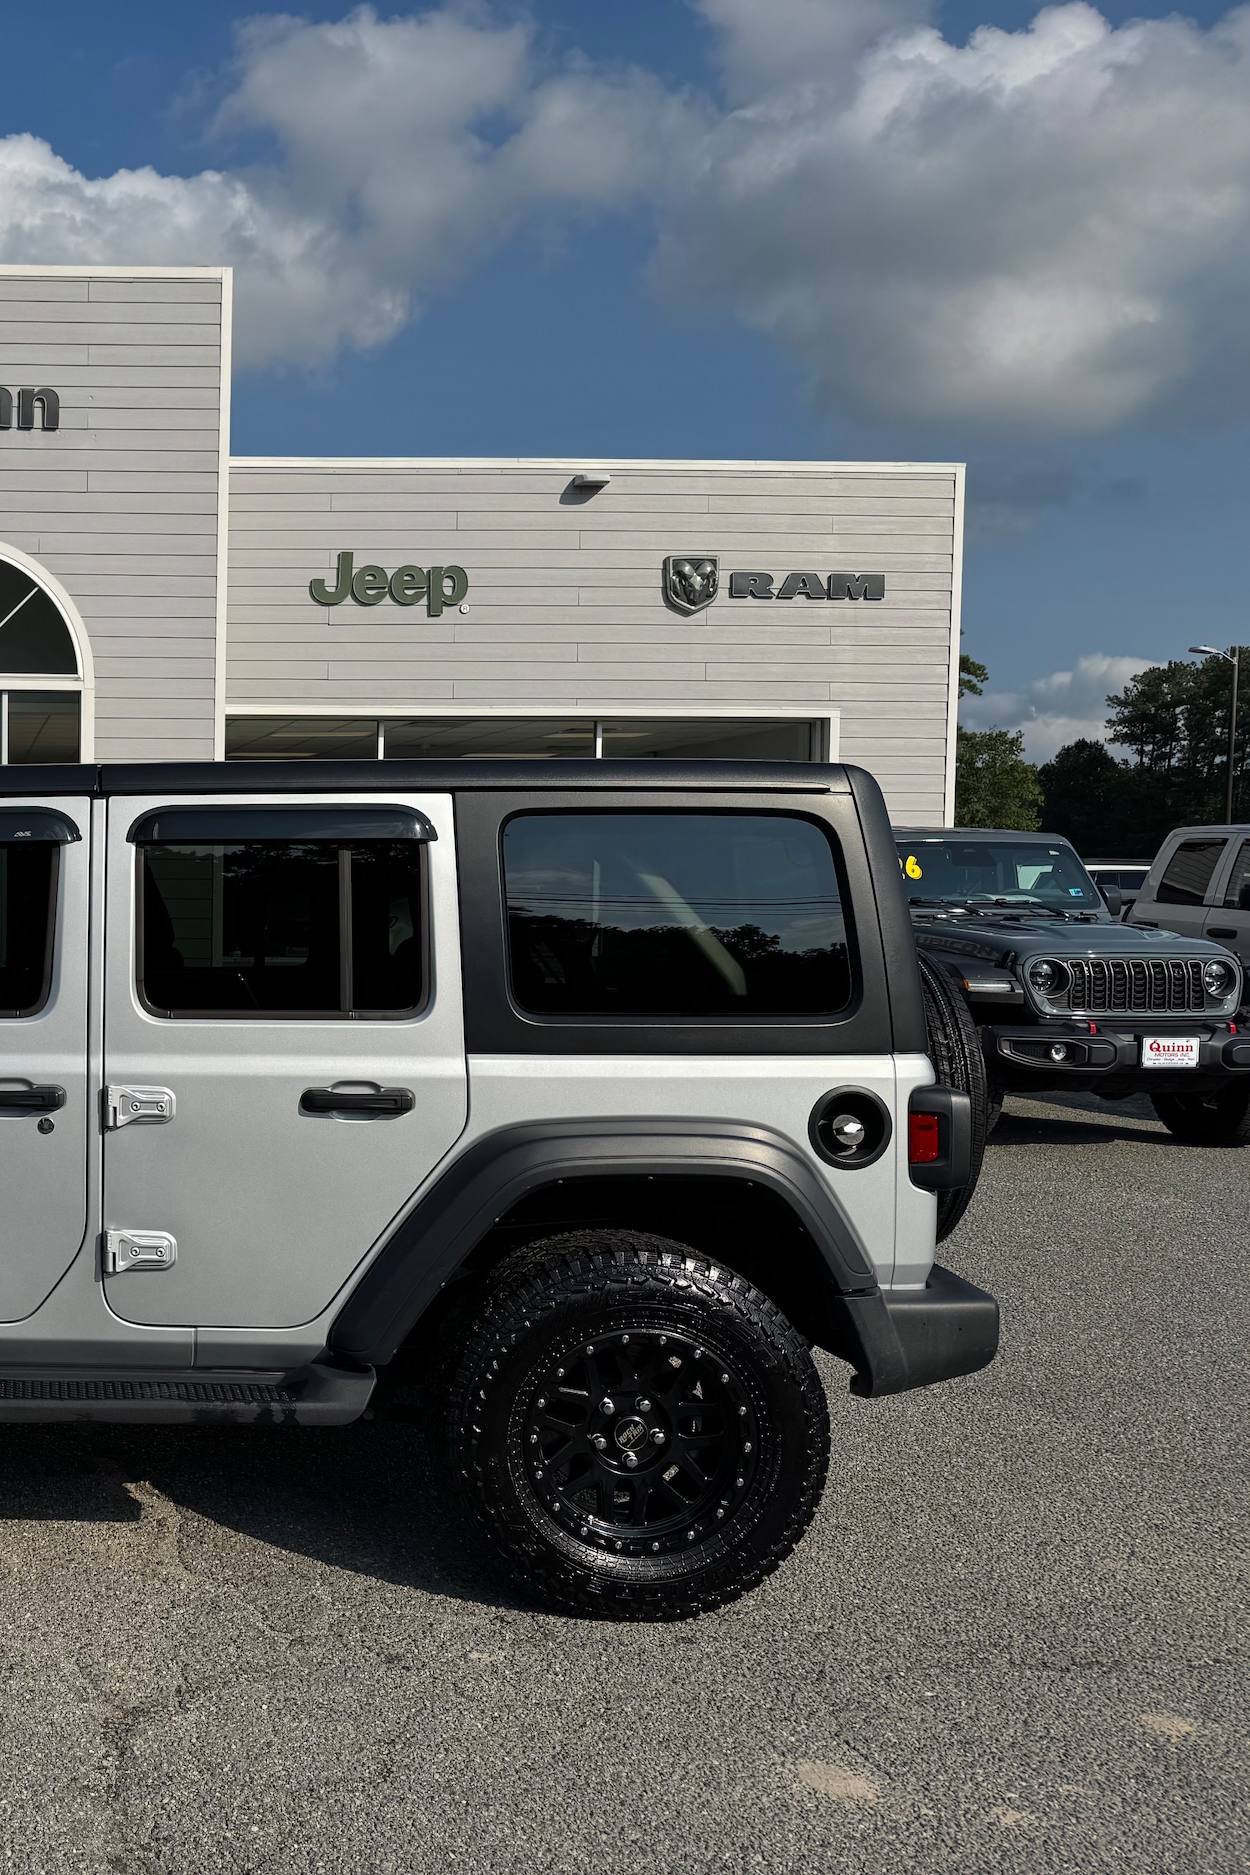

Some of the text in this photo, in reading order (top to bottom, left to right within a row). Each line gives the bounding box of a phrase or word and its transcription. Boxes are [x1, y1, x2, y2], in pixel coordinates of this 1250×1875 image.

[309, 551, 469, 617] Jeep
[729, 572, 885, 600] RAM
[913, 933, 1000, 960] UBICON
[1149, 1041, 1193, 1052] Quinn
